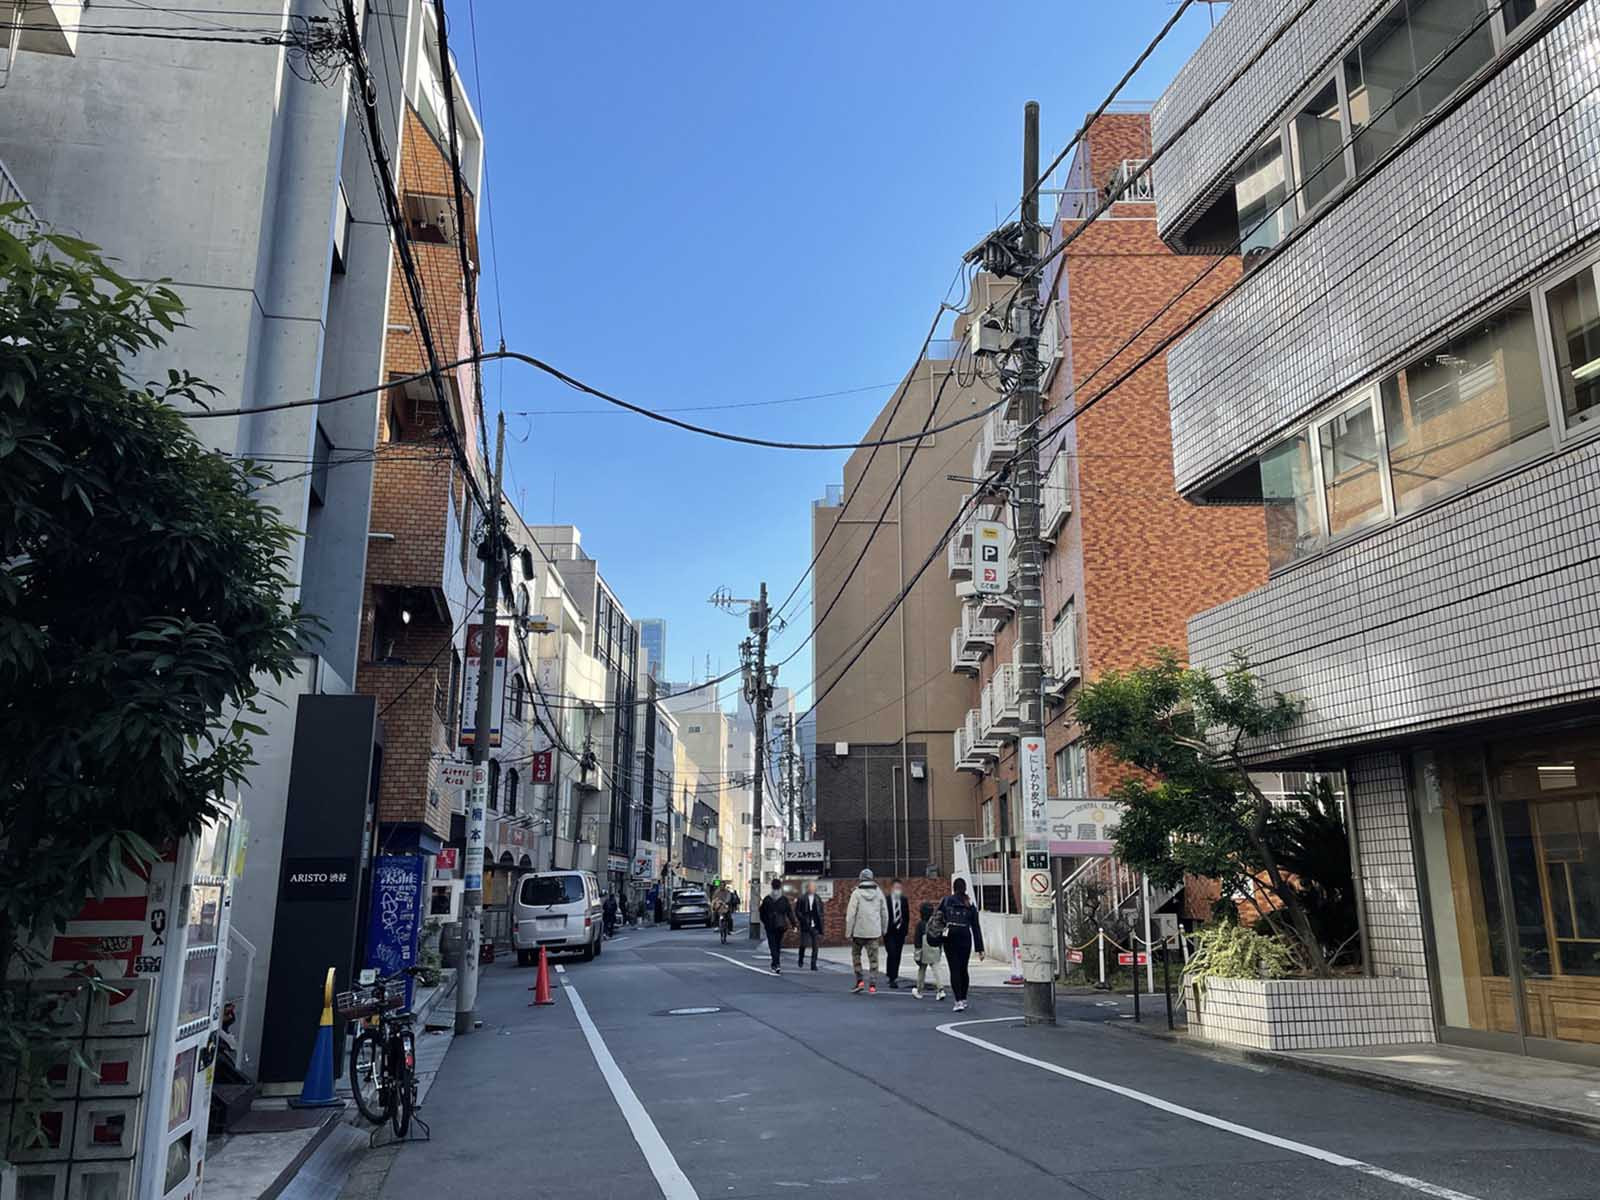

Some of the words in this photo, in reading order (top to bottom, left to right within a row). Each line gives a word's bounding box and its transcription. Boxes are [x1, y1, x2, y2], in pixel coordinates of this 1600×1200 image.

[984, 546, 996, 561] P
[1029, 754, 1042, 818] にしかわ皮フ科
[290, 873, 328, 882] ARISTO
[329, 873, 347, 882] 渋谷
